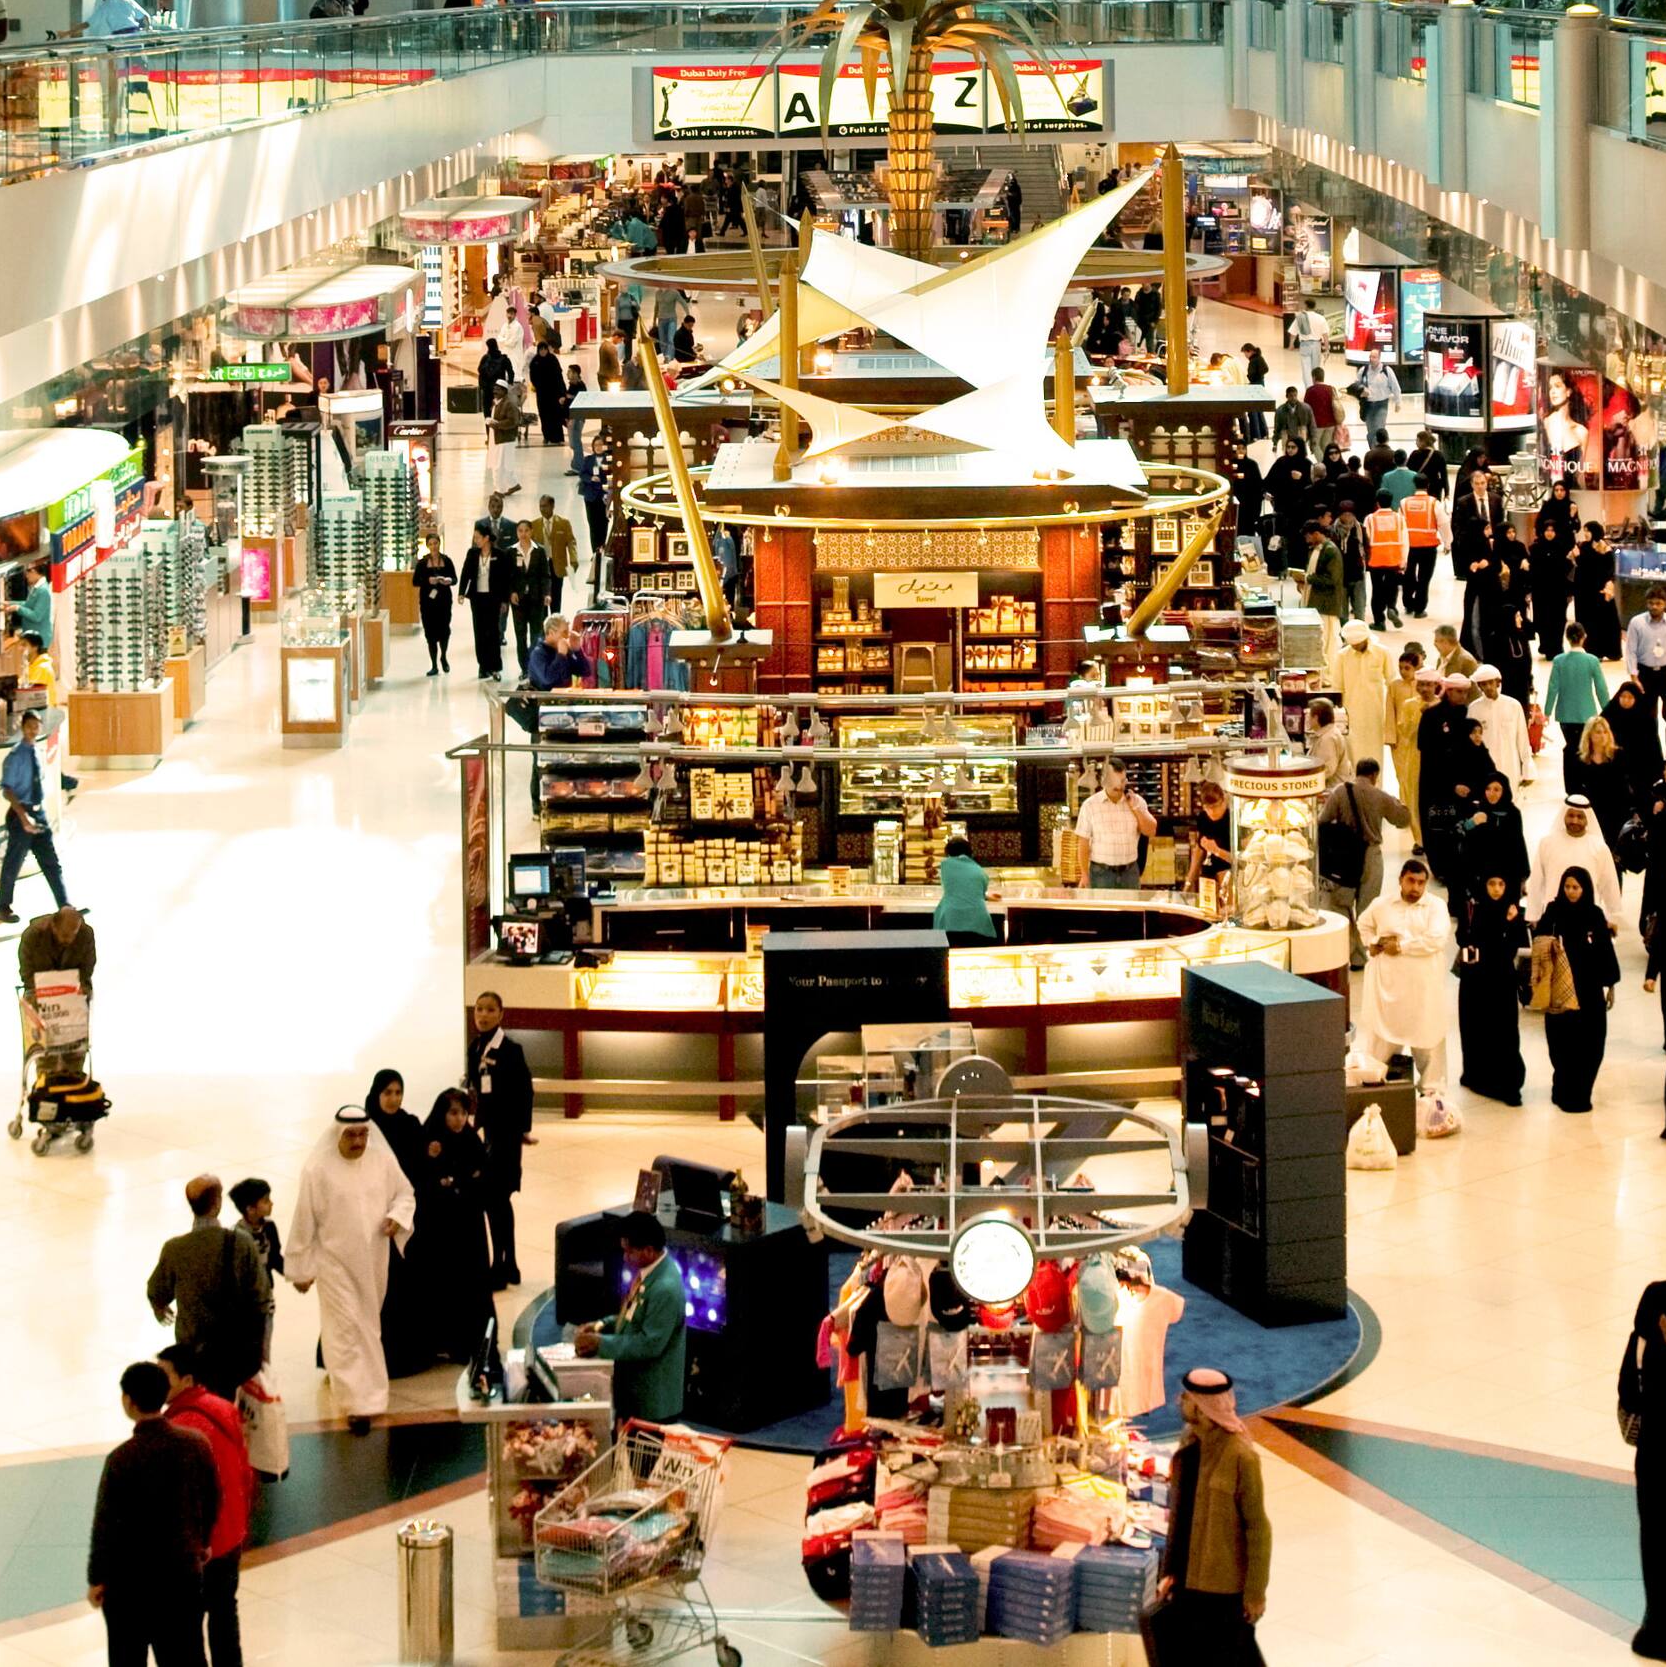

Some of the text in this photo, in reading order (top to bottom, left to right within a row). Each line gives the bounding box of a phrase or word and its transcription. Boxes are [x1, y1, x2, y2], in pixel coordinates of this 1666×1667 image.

[680, 70, 706, 78] Dubai
[707, 70, 727, 79] Duty
[955, 77, 978, 107] Z
[784, 93, 815, 123] A
[1014, 122, 1031, 130] Fll
[1044, 122, 1089, 131] surprises.
[713, 130, 757, 138] surprises.
[393, 426, 428, 437] Cartier
[1229, 778, 1318, 791] PRECIOUS STONES
[789, 976, 815, 987] Your
[817, 974, 868, 989] Passport
[870, 976, 883, 986] to
